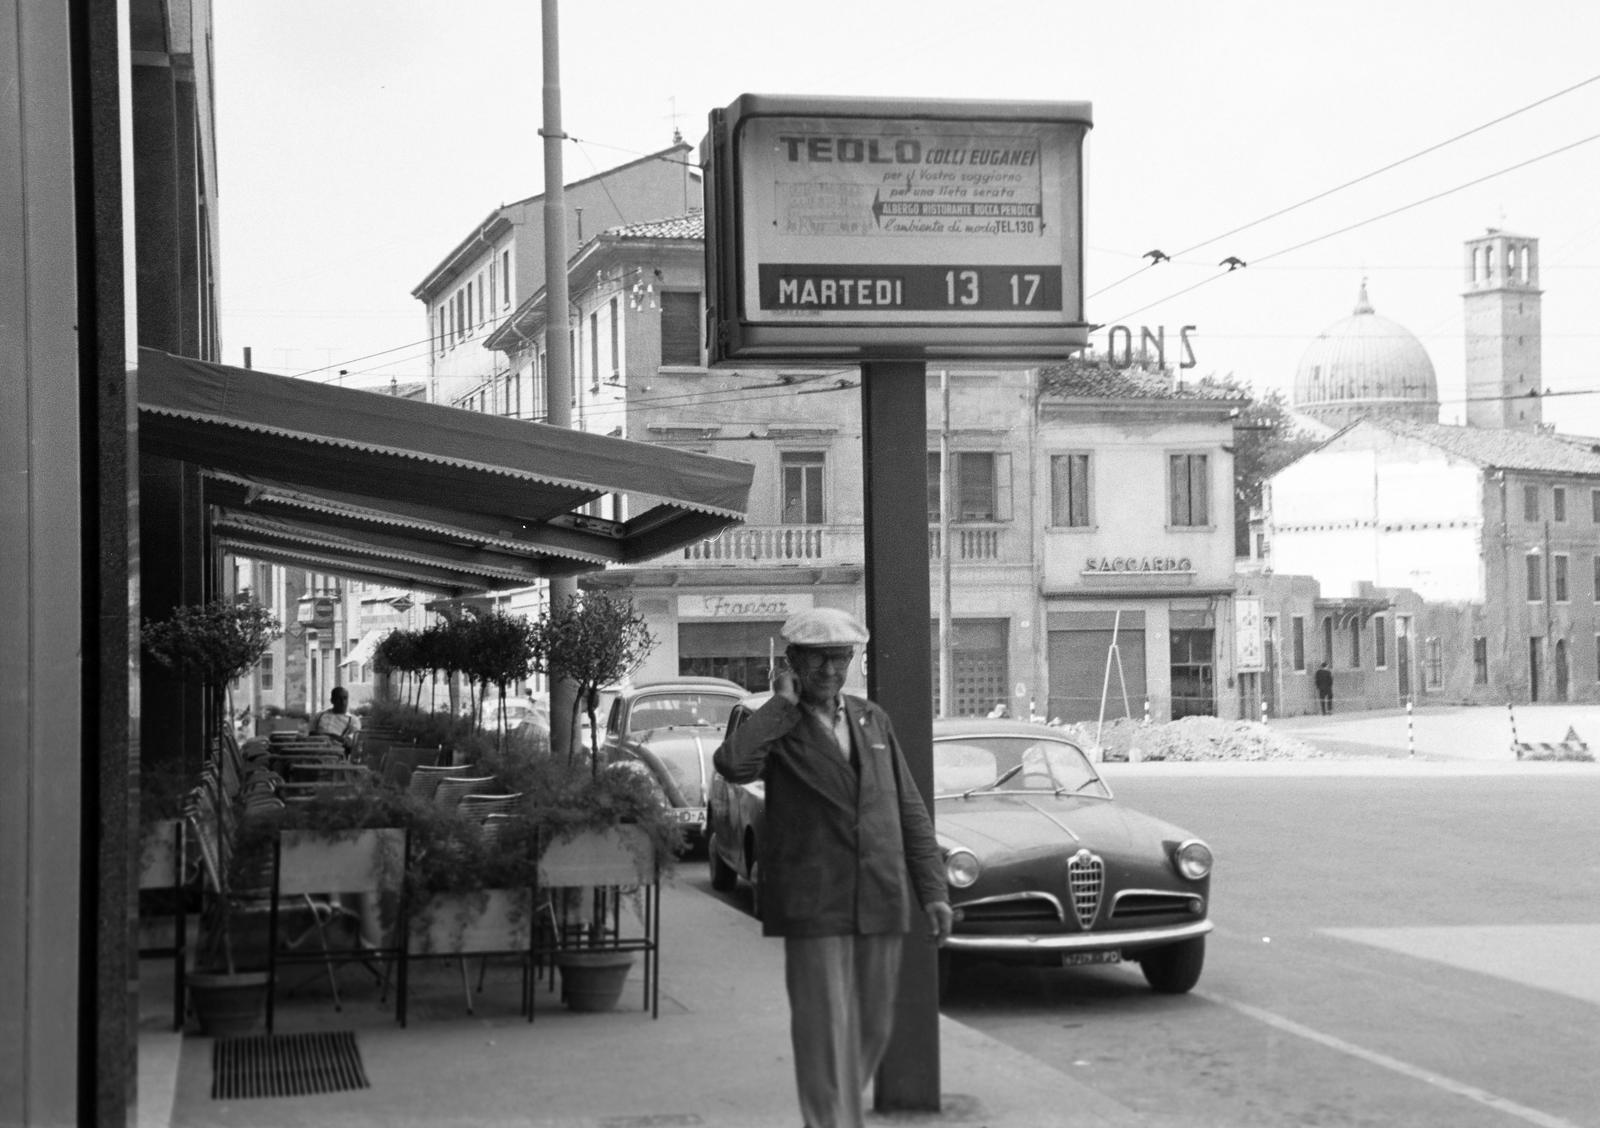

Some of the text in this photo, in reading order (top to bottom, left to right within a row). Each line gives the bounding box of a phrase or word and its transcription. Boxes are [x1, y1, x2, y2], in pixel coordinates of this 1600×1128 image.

[779, 136, 922, 165] TEOLO
[925, 148, 1037, 167] COLLI EUGANEI
[882, 171, 901, 183] per
[920, 169, 956, 182] Vostro
[960, 170, 1023, 184] soggiorno
[889, 187, 910, 198] per
[913, 187, 935, 197] una
[973, 185, 1016, 198] serata
[882, 203, 920, 215] ALBERGO
[922, 203, 973, 216] RISTORANTE
[947, 218, 962, 233] di
[778, 270, 1042, 306] MARTEDI 13 17
[1085, 556, 1192, 572] SACCARDO
